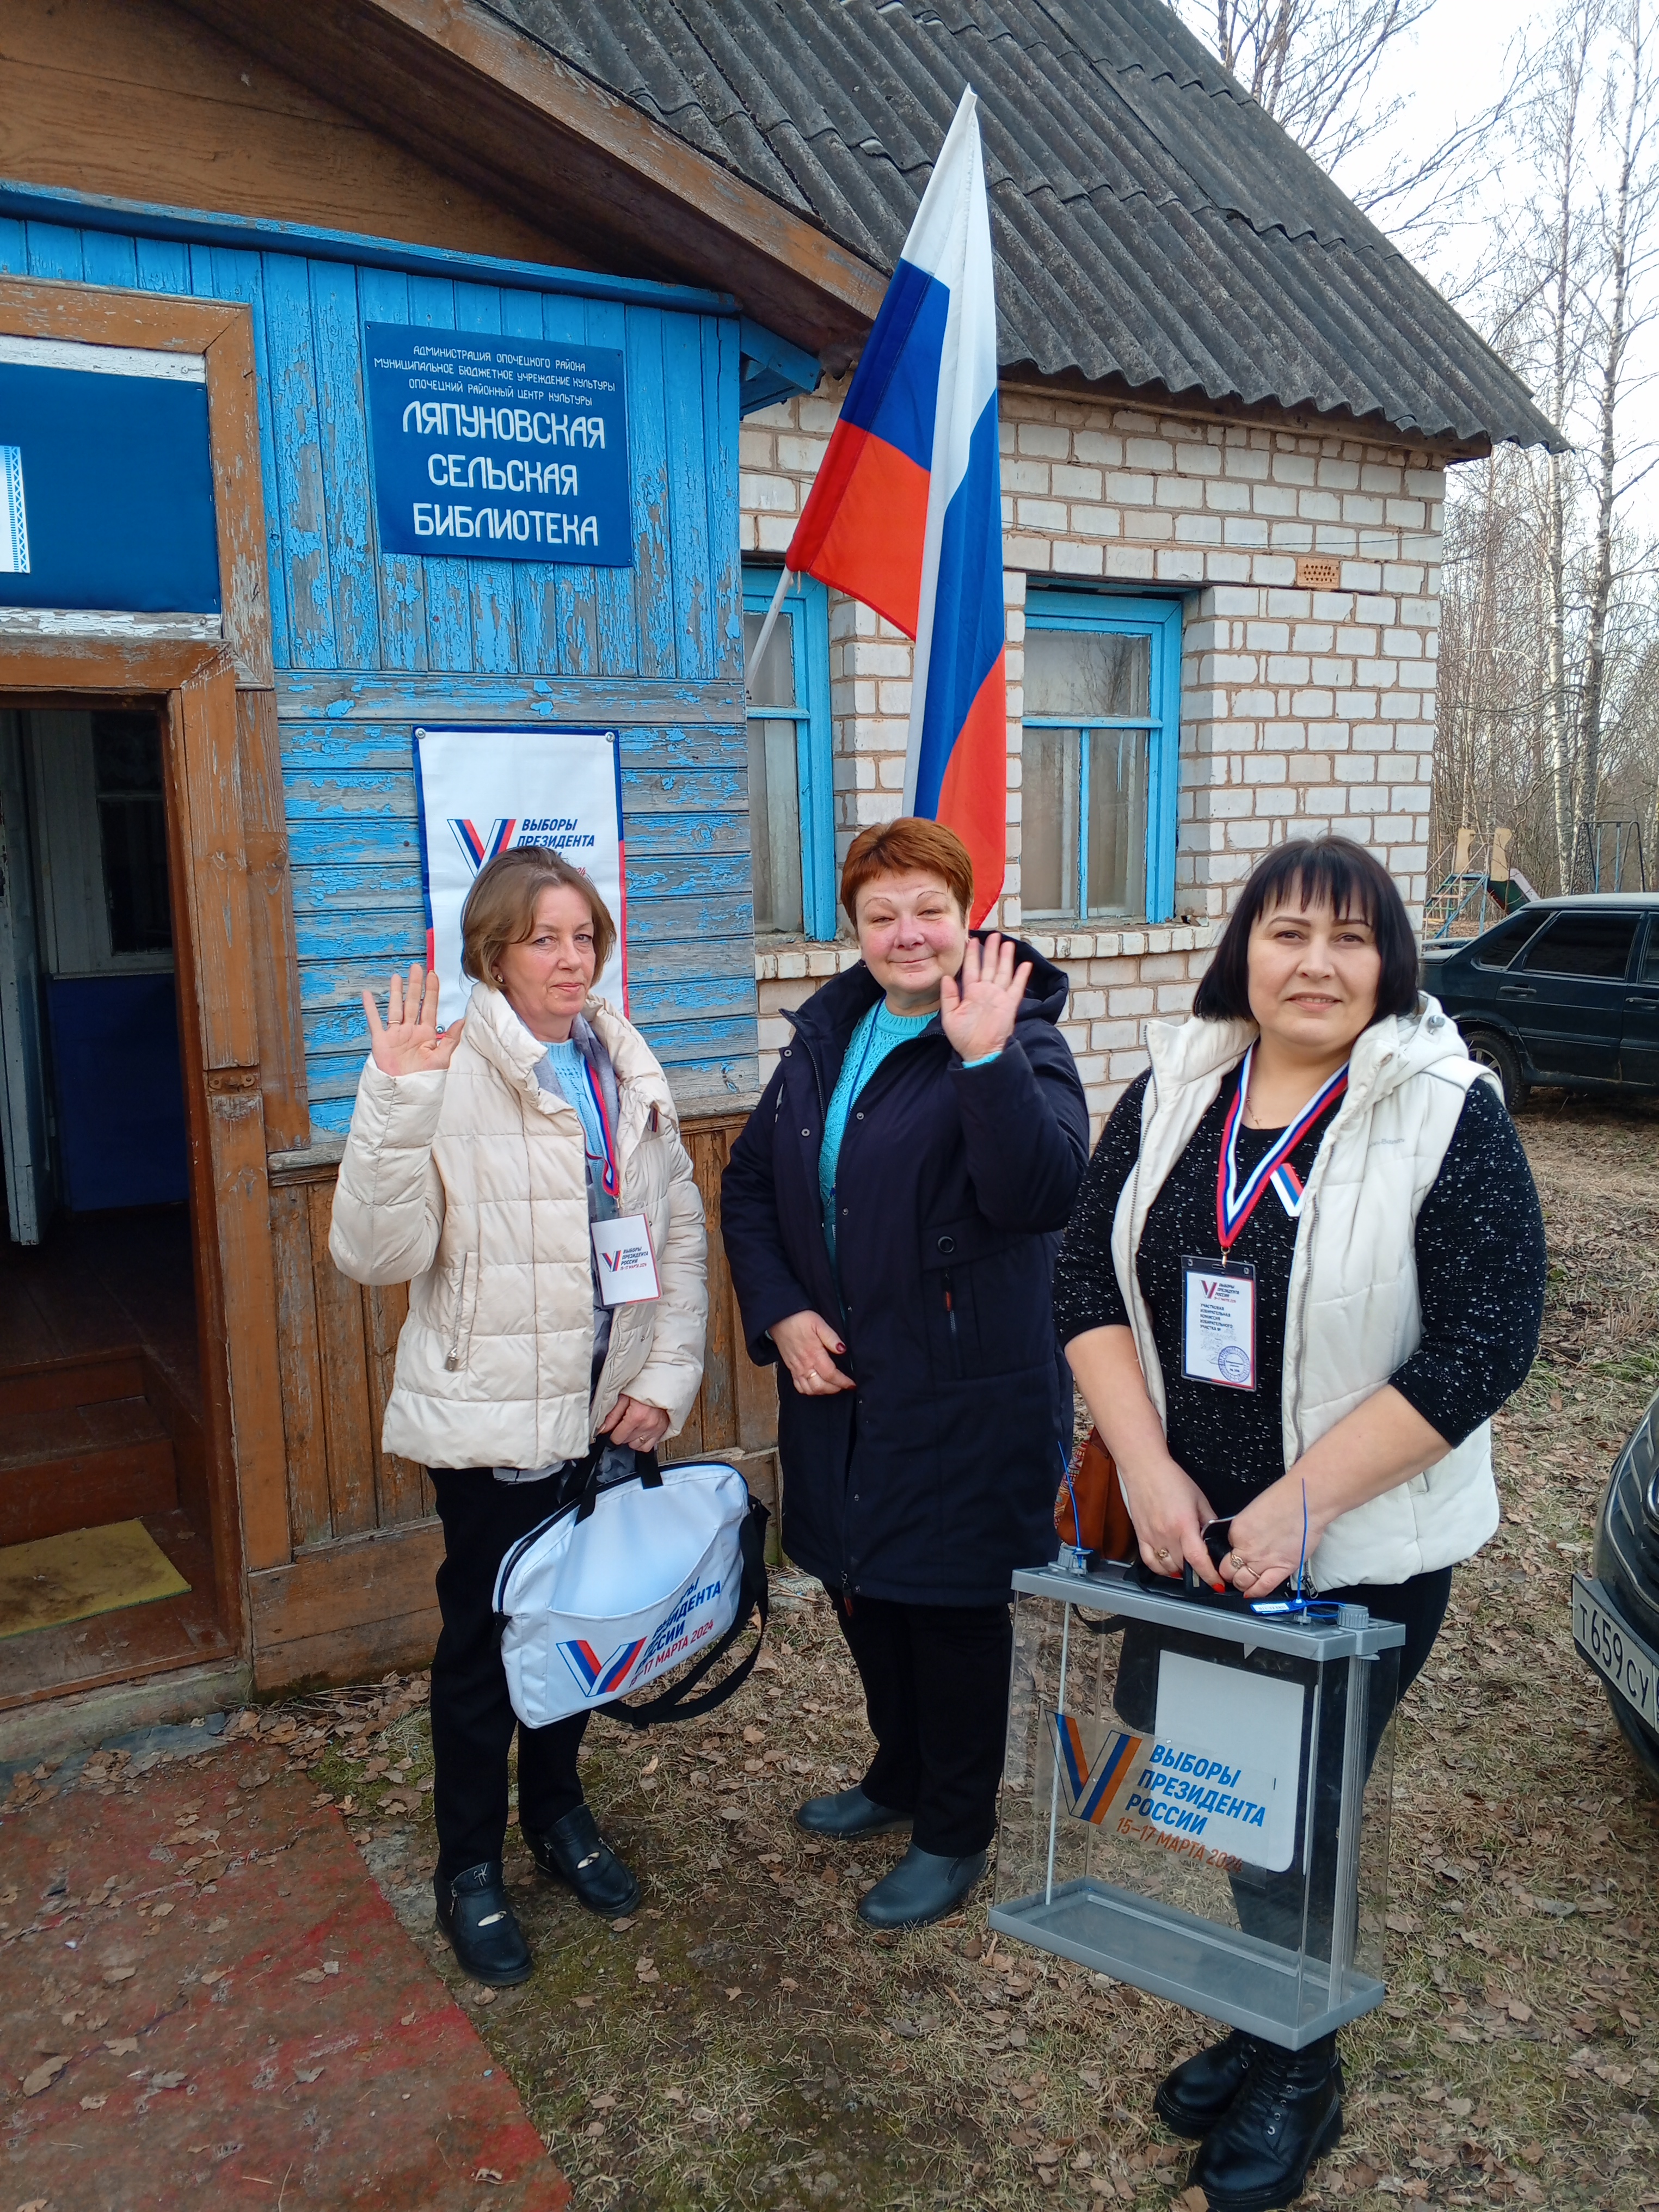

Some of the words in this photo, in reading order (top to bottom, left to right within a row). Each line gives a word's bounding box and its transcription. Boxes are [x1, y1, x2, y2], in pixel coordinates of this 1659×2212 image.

[374, 358, 454, 374] МУНИЦИПАЛЬНОЕ
[458, 365, 513, 380] БЮДЖЕТНОЕ
[517, 372, 570, 386] УЧРЕЖДЕНИЕ
[573, 377, 616, 391] КУЛЬТУРЫ
[413, 346, 491, 361] АДМИНИСТРАЦИЯ
[496, 353, 551, 368] ОПОЧЕЦКОГО
[555, 359, 586, 372] РАЙОНА
[409, 378, 463, 392] ОПОЧЕЦКИЙ
[468, 383, 514, 398] РАЙОННЫЙ
[517, 389, 544, 401] ЦЕНТР
[548, 392, 593, 406] КУЛЬТУРЫ
[403, 400, 605, 449] ЛЯПУНОВСКАЯ
[428, 453, 578, 496] СЕЛЬСКАЯ
[413, 502, 599, 546] БИБЛИОТЕКА
[518, 835, 595, 849] ПРЕЗИДЕНТА
[521, 819, 578, 831] ВЫБОРЫ
[622, 1251, 648, 1259] ПРЕЗИДЕНТА
[1200, 1308, 1231, 1317] ИЗБИРАТЕЛЬНАЯ
[1200, 1319, 1233, 1328] ИЗБИРАТЕЛЬНОГО
[655, 1635, 689, 1668] МАРТА
[690, 1619, 714, 1644] 2024
[1149, 1744, 1242, 1788] ВЫБОРЫ
[1125, 1793, 1208, 1835] РОССИИ
[1137, 1769, 1265, 1827] ПРЕЗИДЕНТА
[1156, 1830, 1206, 1861] МАРТА
[1206, 1848, 1243, 1872] 2024
